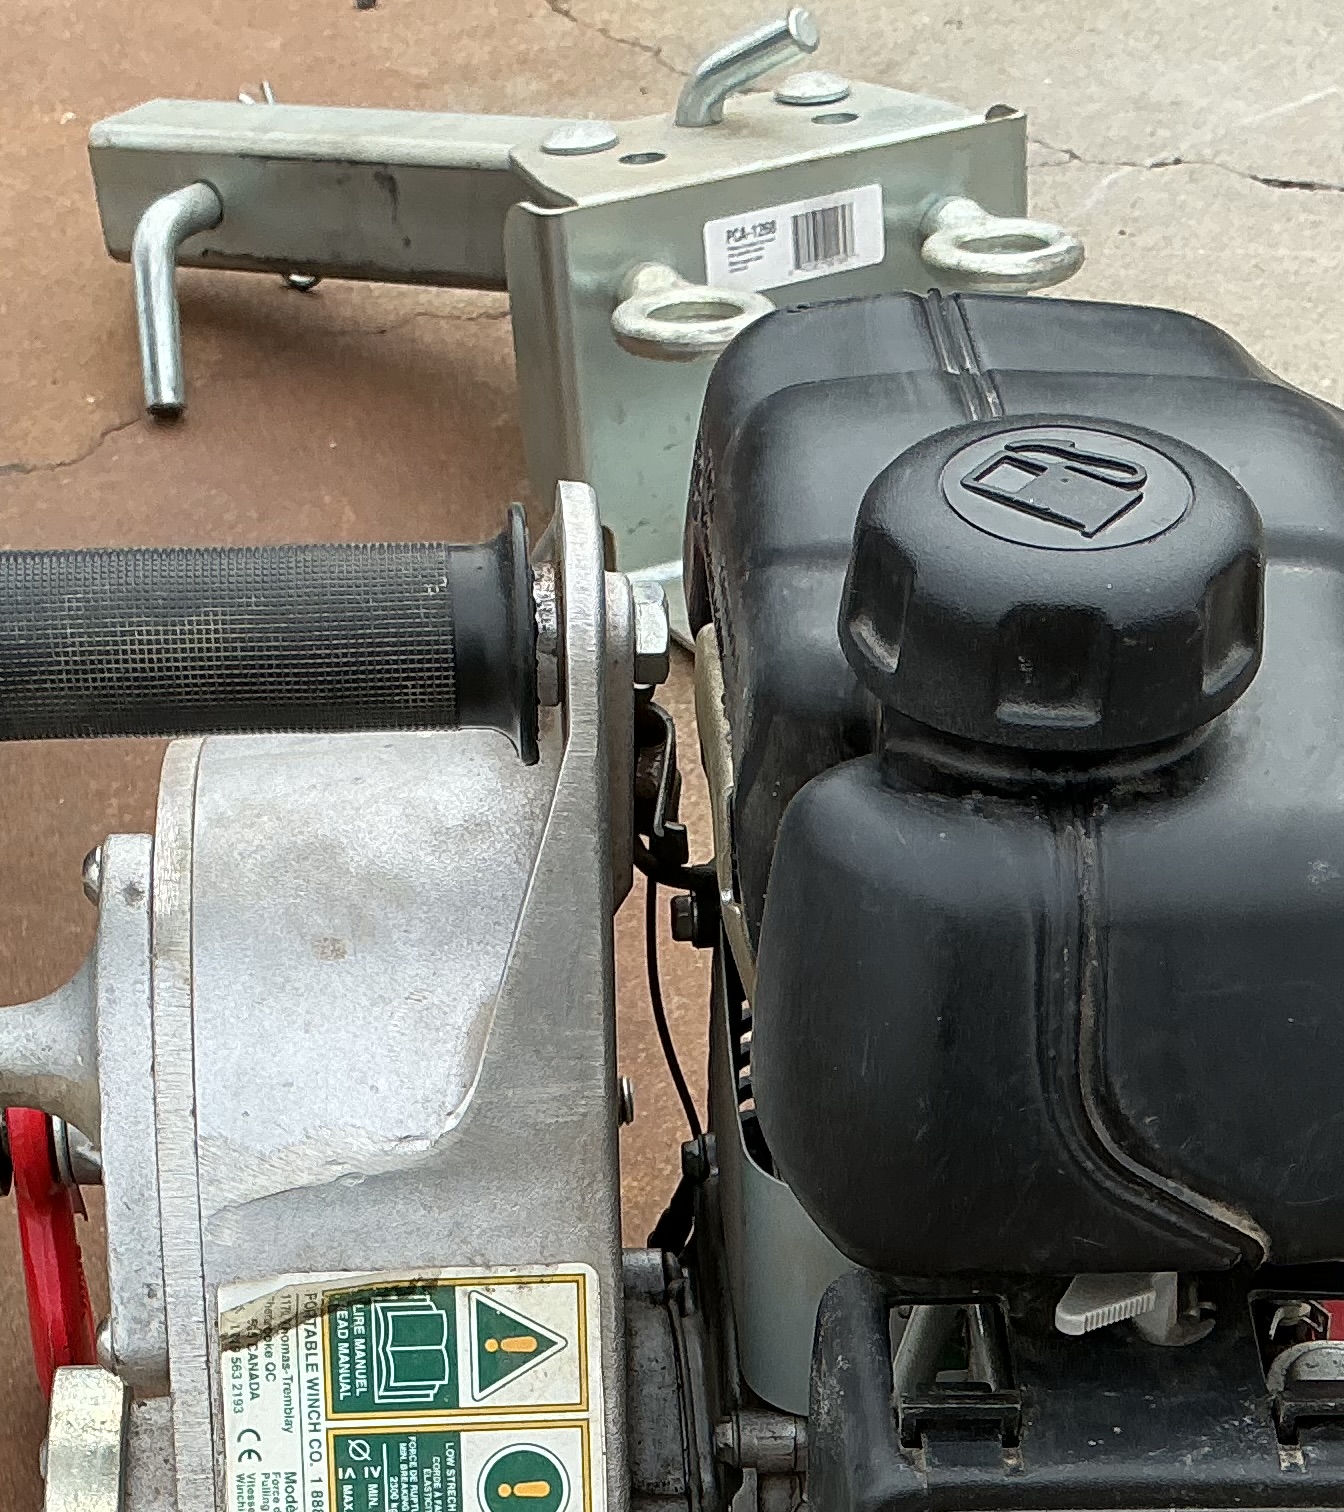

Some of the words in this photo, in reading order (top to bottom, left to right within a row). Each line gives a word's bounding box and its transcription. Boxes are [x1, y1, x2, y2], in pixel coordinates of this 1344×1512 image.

[336, 1303, 350, 1340] EAD
[353, 1304, 366, 1336] LIRE
[230, 1356, 242, 1380] 563
[265, 1362, 277, 1383] QC
[338, 1341, 352, 1401] MANUAL
[355, 1338, 368, 1397] MANUEL
[232, 1383, 244, 1415] 2193
[307, 1377, 322, 1433] WINCH
[308, 1438, 324, 1467] CO.
[445, 1442, 456, 1468] LOW
[260, 1472, 271, 1511] Pulling
[367, 1484, 379, 1510] MIN.
[446, 1468, 457, 1512] STRECH
